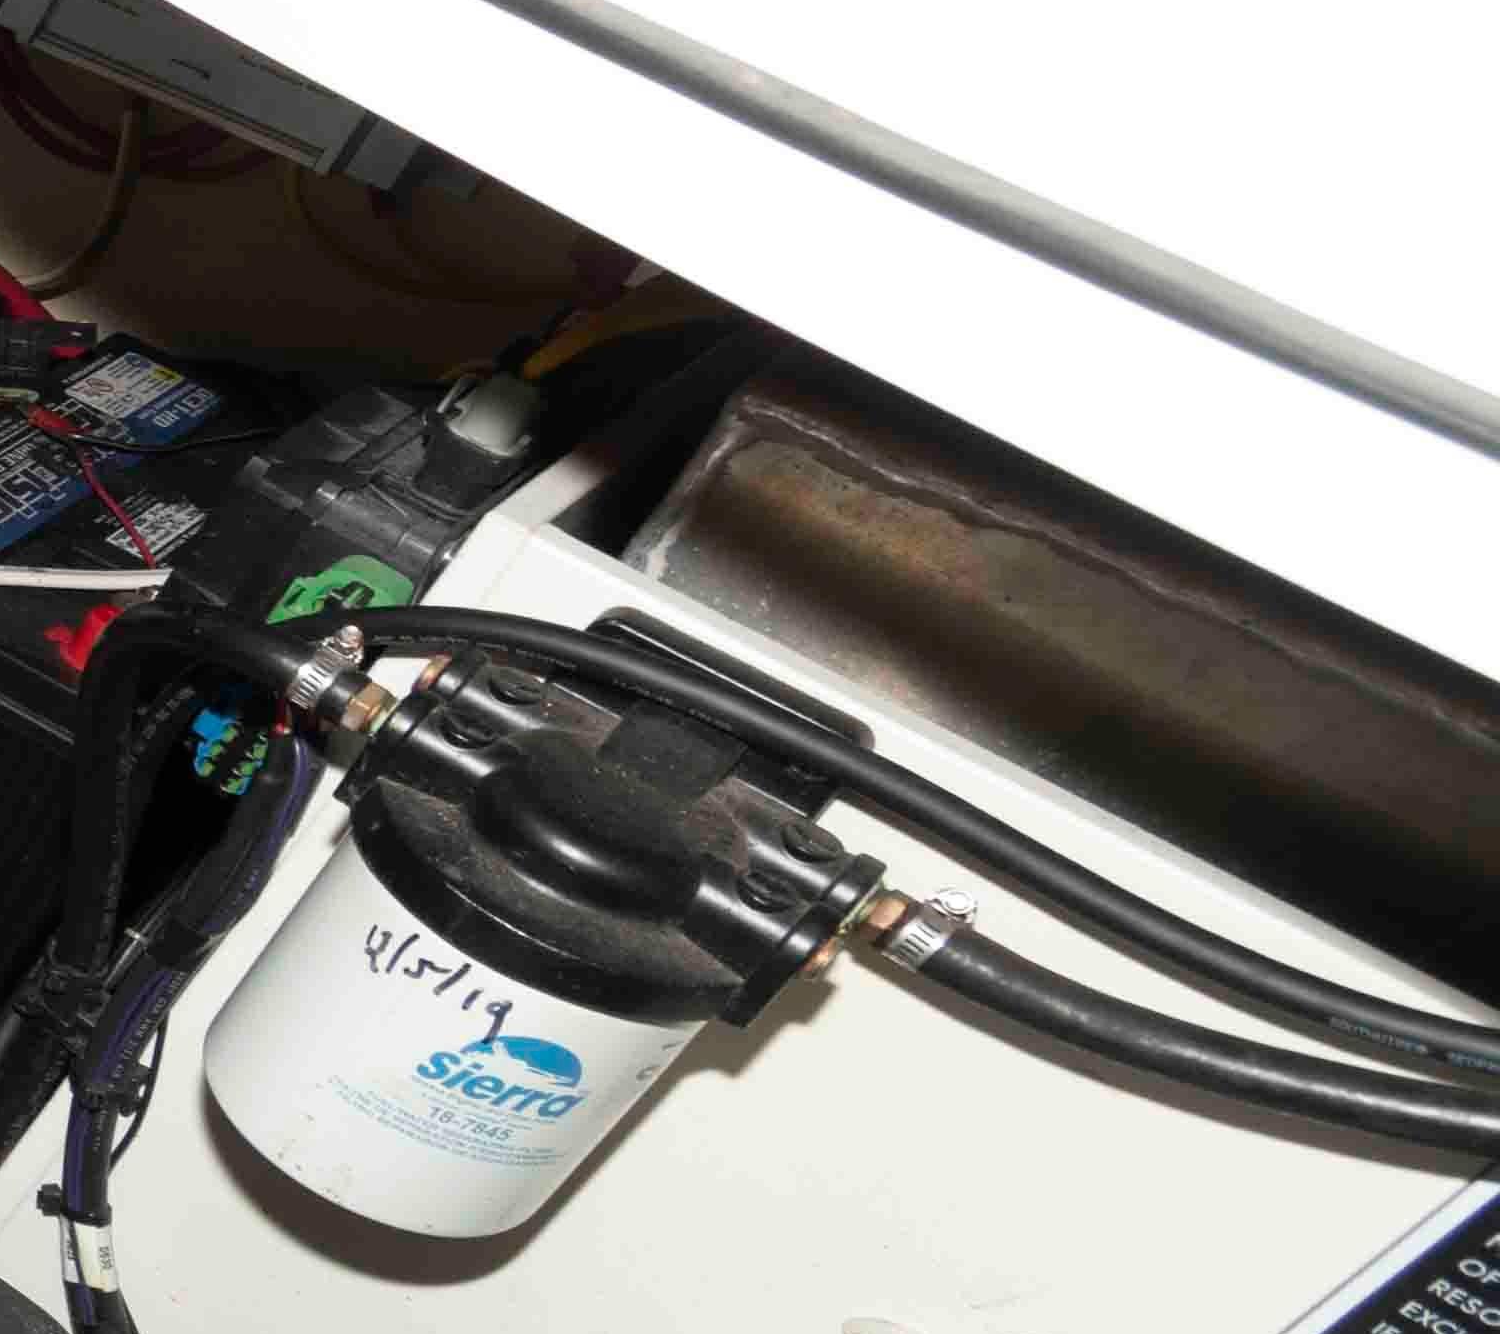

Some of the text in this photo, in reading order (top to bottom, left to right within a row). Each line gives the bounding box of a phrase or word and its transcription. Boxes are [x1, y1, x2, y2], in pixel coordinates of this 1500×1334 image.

[416, 1051, 584, 1118] sierra
[427, 1105, 515, 1142] 18-7845
[1428, 1278, 1500, 1327] RESO
